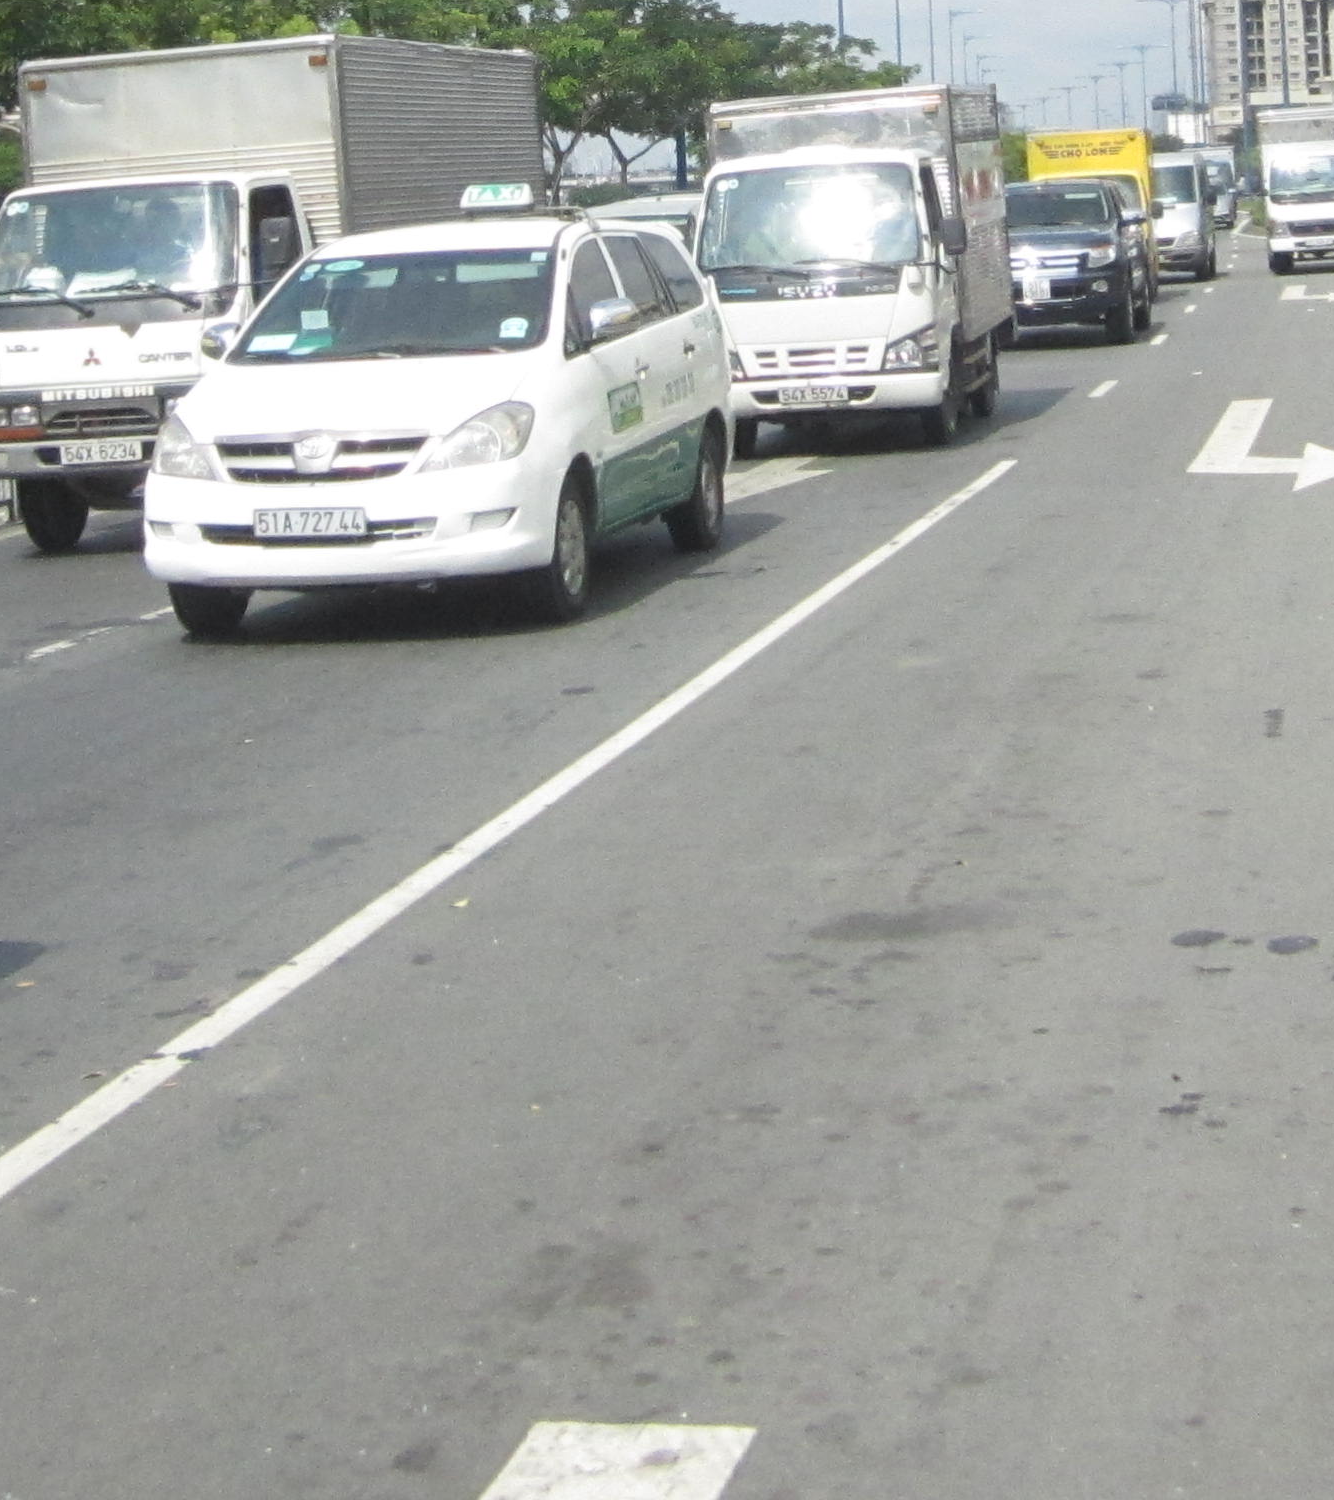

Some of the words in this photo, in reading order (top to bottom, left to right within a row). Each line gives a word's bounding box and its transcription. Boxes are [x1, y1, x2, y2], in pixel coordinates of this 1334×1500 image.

[467, 185, 526, 202] TAXI
[778, 283, 837, 298] ISUZU
[41, 385, 155, 402] MITSUBISHI
